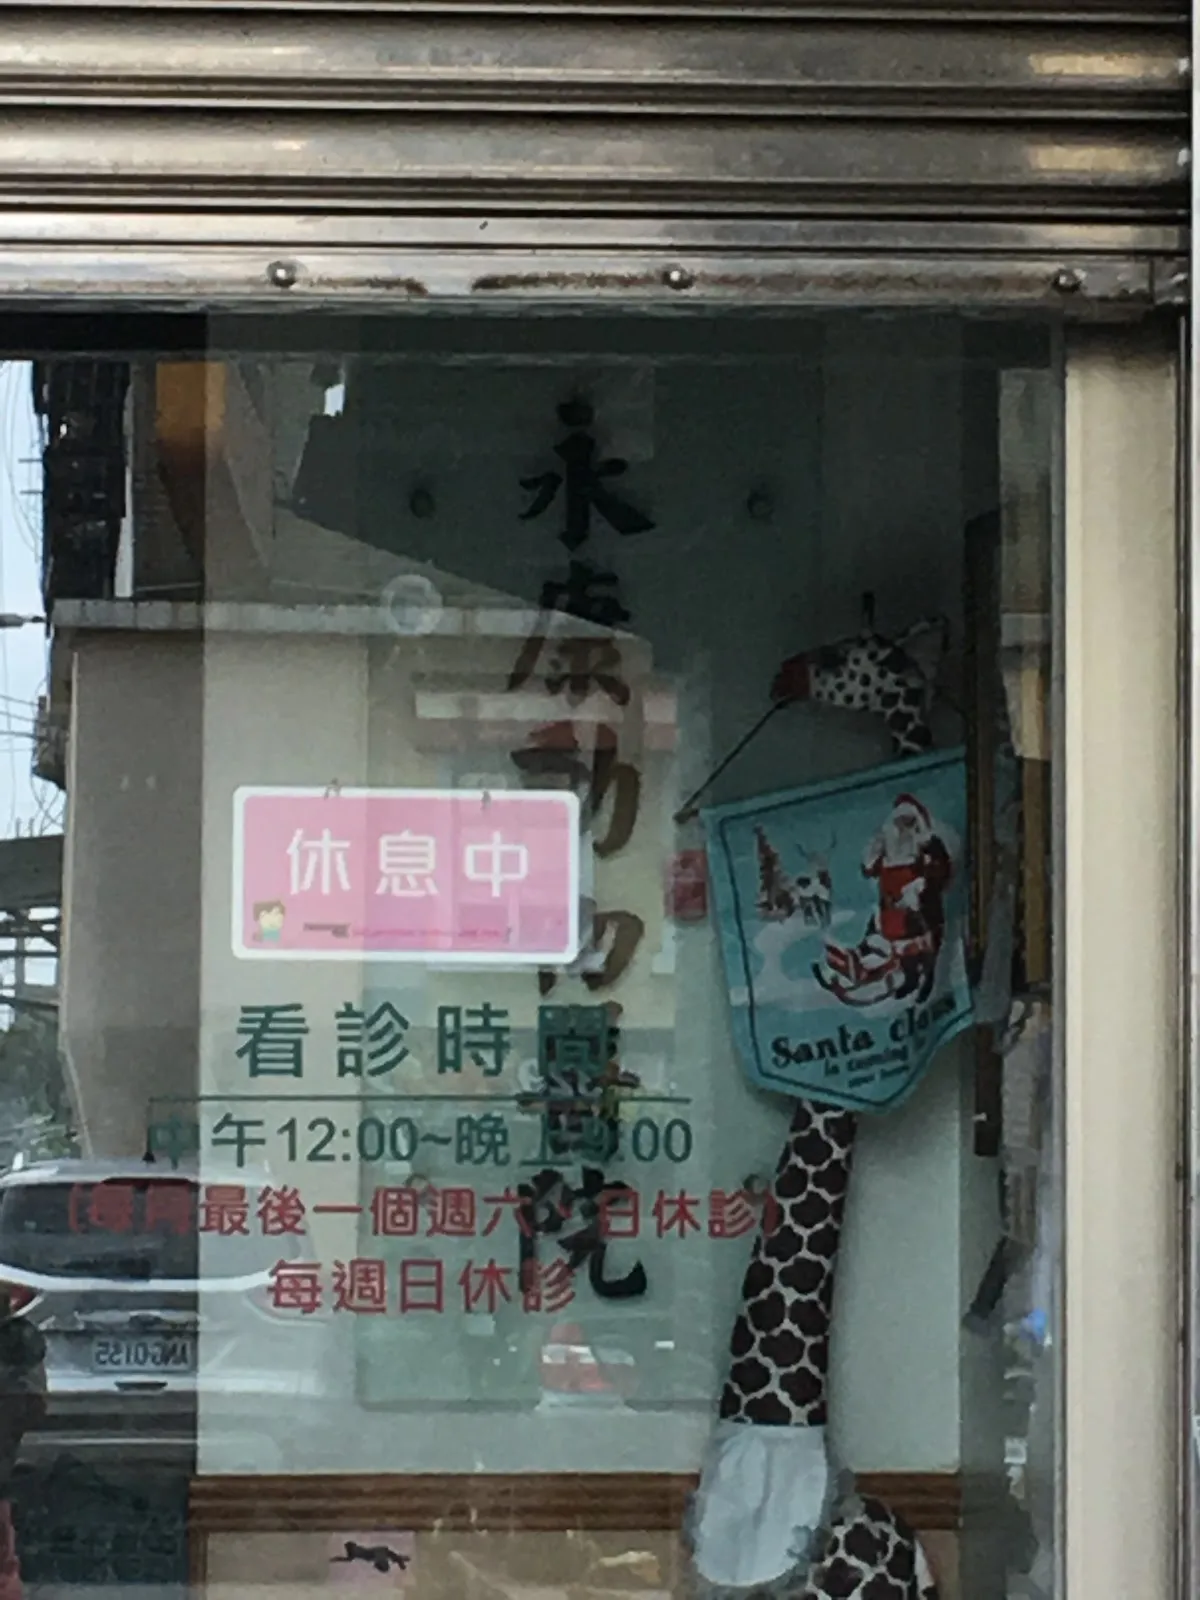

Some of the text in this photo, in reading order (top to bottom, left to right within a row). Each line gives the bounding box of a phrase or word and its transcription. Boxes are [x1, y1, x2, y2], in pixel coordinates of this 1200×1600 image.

[286, 828, 530, 898] 休息中
[236, 1001, 608, 1081] 看診時間
[770, 1024, 876, 1070] Santa
[267, 1257, 577, 1315] 每週日休診
